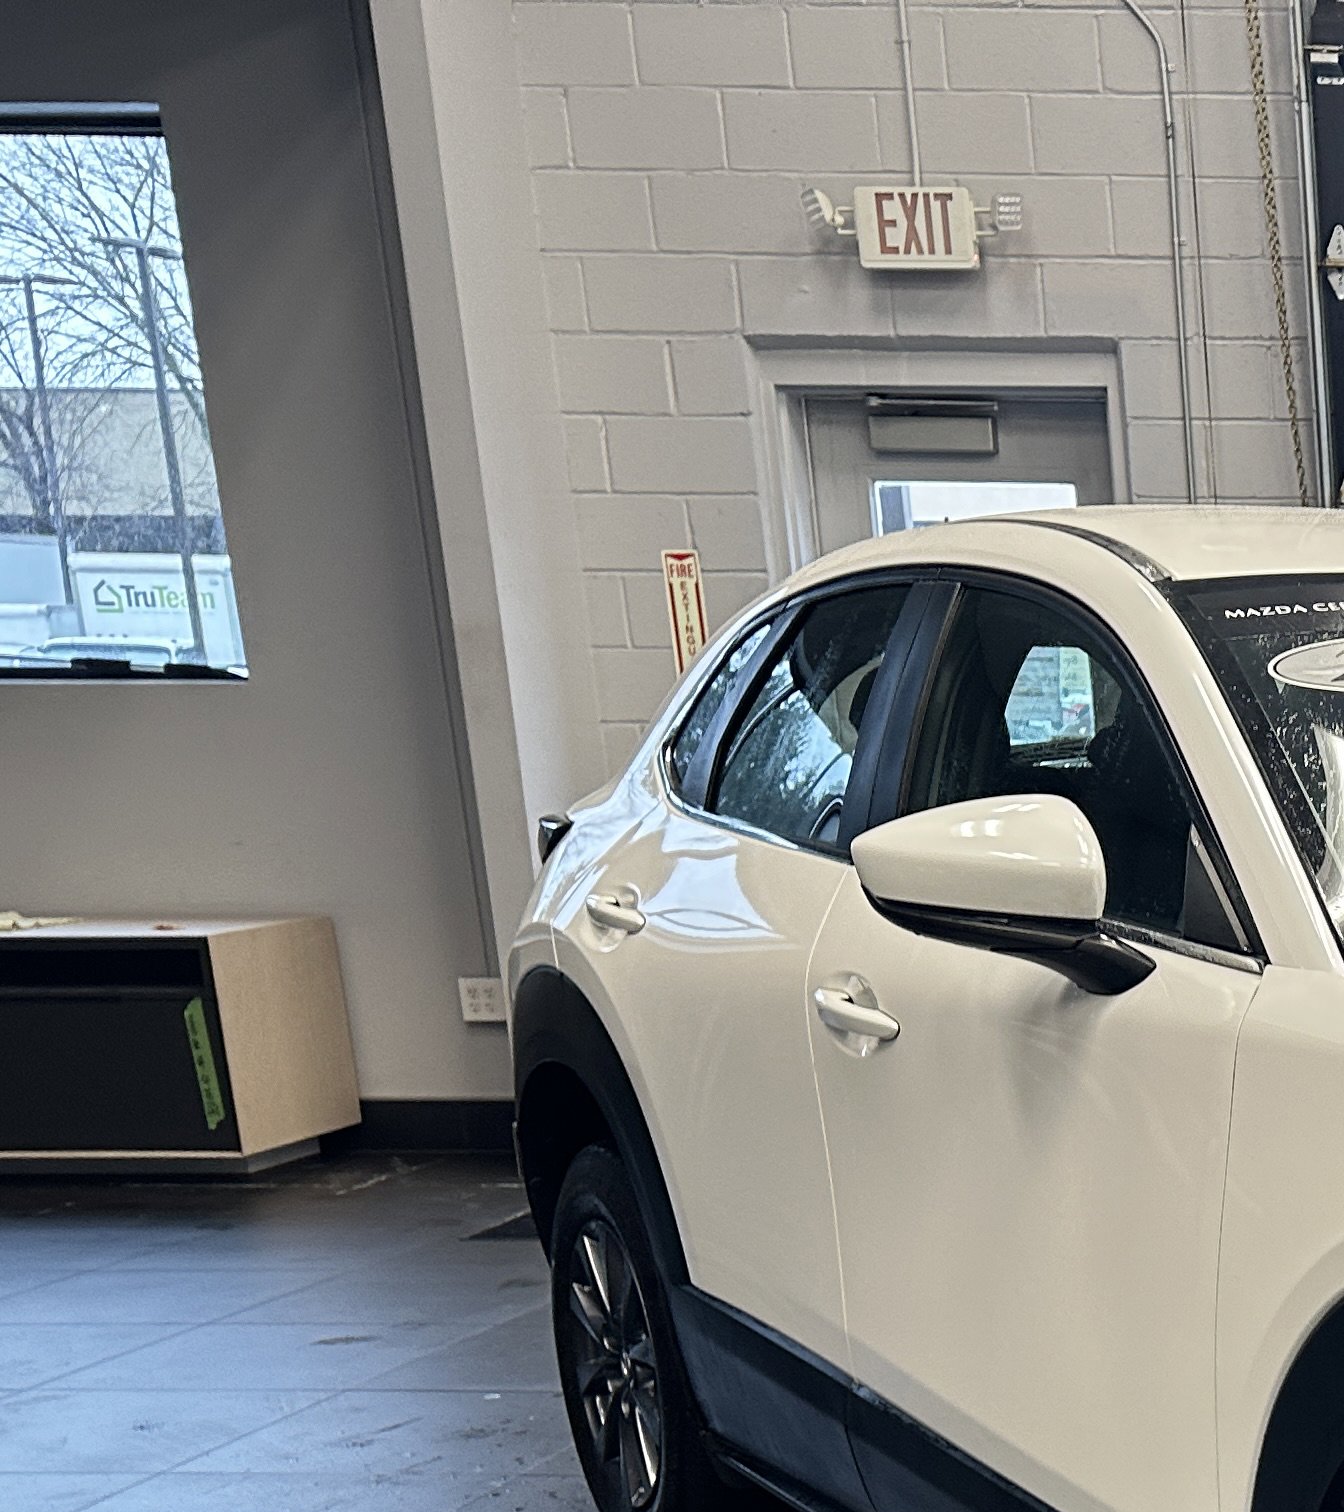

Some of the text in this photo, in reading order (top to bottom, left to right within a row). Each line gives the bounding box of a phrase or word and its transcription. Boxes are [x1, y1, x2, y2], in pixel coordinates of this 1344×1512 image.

[874, 192, 953, 255] EXIT
[669, 563, 694, 578] FIRE
[1224, 603, 1308, 619] MAZDA
